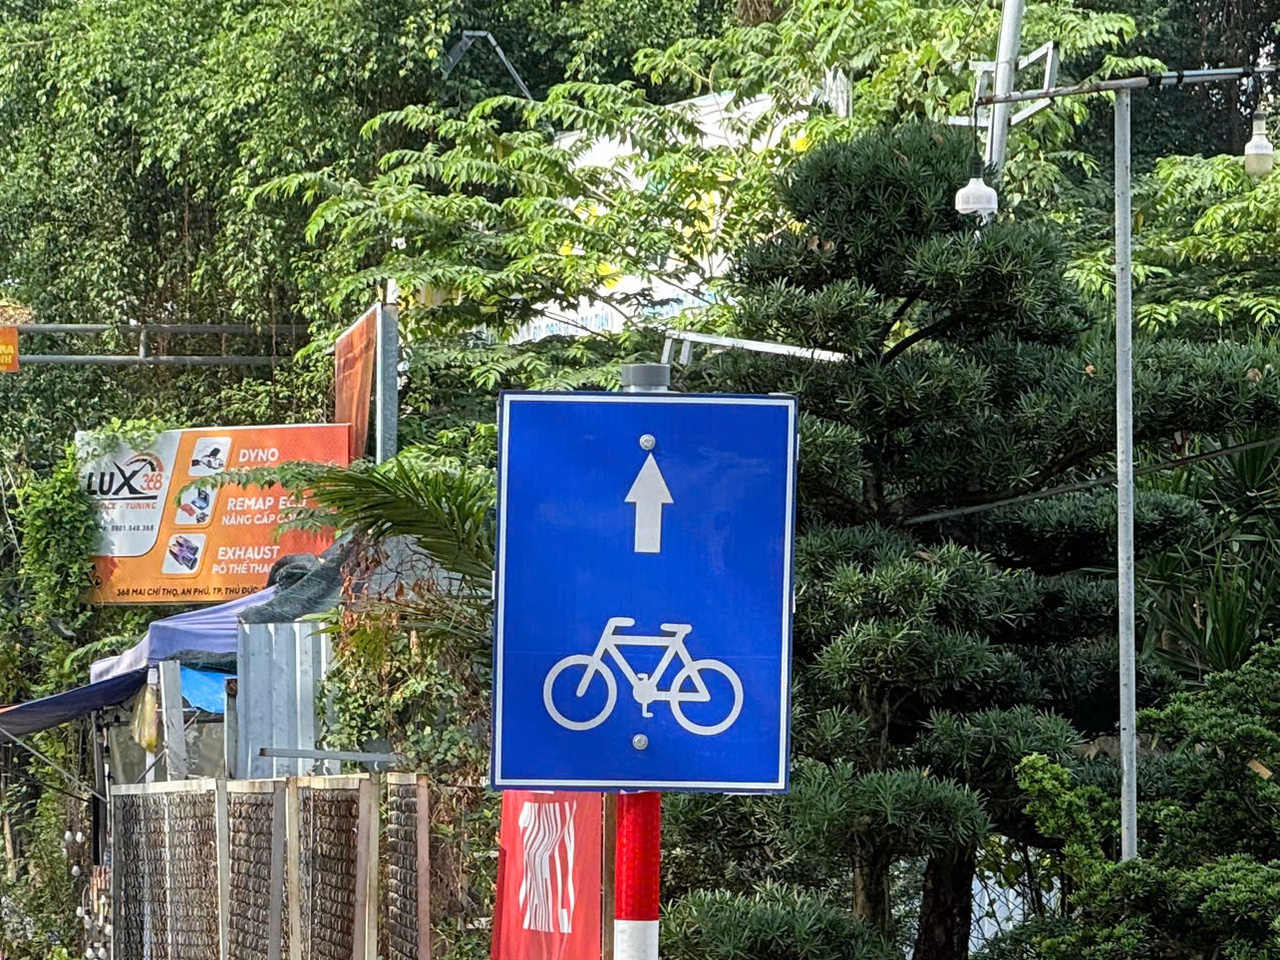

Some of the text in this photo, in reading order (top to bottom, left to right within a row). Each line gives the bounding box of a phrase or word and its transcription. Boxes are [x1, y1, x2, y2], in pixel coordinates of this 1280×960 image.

[238, 447, 279, 463] DYNO
[86, 461, 148, 495] LUX
[140, 473, 163, 491] 368
[126, 502, 157, 510] TUNING
[227, 496, 274, 511] REMAP
[218, 545, 280, 560] EXHAUST
[116, 588, 131, 597] 368
[131, 588, 146, 596] MAI
[180, 587, 193, 596] AN
